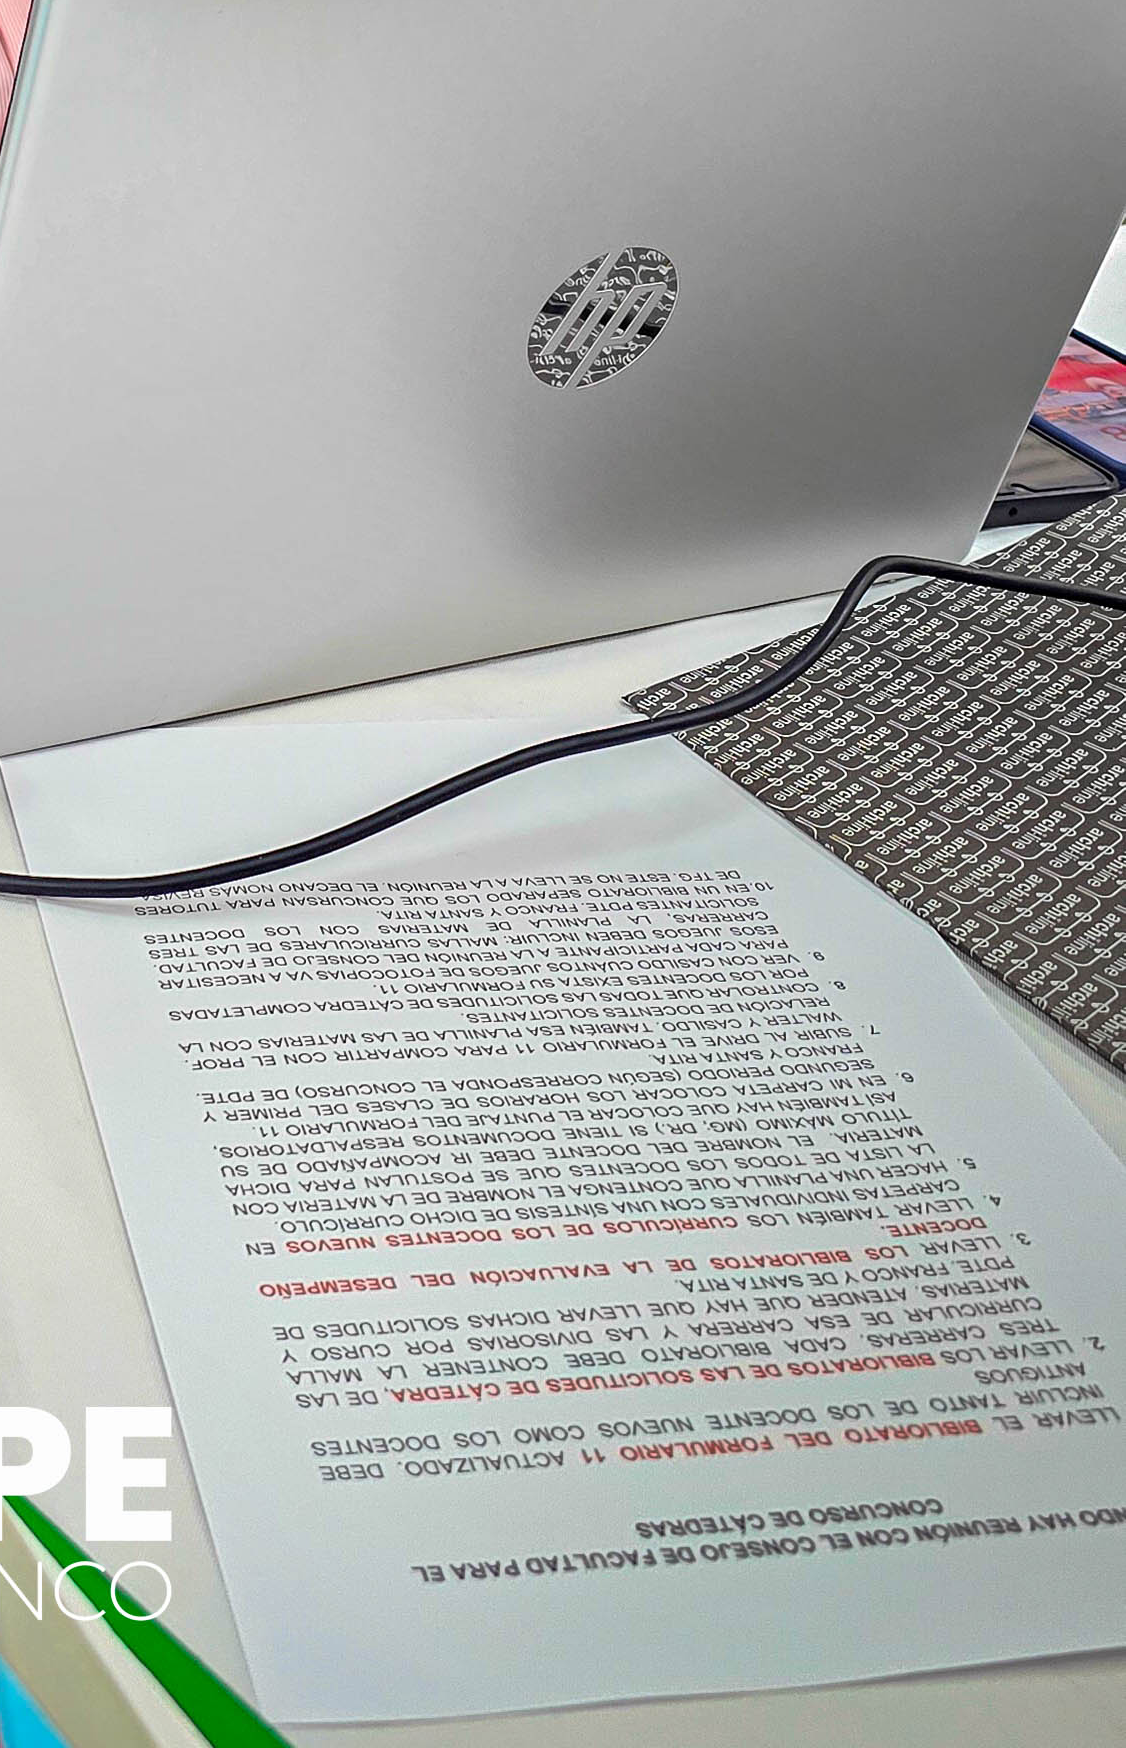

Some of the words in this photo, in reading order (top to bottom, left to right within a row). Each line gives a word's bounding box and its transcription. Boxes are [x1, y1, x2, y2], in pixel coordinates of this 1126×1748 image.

[378, 923, 469, 935] MATERIAS
[485, 921, 512, 932] DE
[528, 916, 612, 929] PLANILLA
[627, 915, 652, 925] LA
[143, 928, 245, 945] DOCENTES
[264, 925, 302, 936] LOS
[319, 924, 361, 936] CON
[746, 1213, 790, 1227] LOS
[796, 1205, 890, 1226] TAMBIÉN
[511, 1225, 555, 1240] LOS
[562, 1223, 594, 1237] DE
[602, 1216, 738, 1234] CURRÍCULOS
[285, 1236, 376, 1254] NUEVOS
[385, 1229, 503, 1247] DOCENTES
[245, 1242, 276, 1256] EN
[864, 1245, 909, 1261] LOS
[622, 1260, 654, 1274] LA
[665, 1258, 698, 1272] DE
[709, 1250, 853, 1270] BIBLIORATOS
[410, 1273, 456, 1287] DEL
[469, 1263, 611, 1287] EVALUACIÓN
[259, 1276, 397, 1299] DESEMPEÑO
[991, 1415, 1024, 1431] EL
[1031, 1406, 1121, 1429] LLEVAR
[783, 1431, 833, 1449] DEL
[844, 1419, 984, 1444] BIBLIORATO
[581, 1447, 606, 1464] 11
[619, 1435, 775, 1462] FORMULARIO
[318, 1463, 385, 1481] DEBE
[397, 1450, 564, 1478] ACTUALIZADO.
[768, 1510, 806, 1529] DE
[808, 1498, 944, 1526] CONCURSO
[635, 1513, 766, 1540] CÁTEDRAS
[912, 1517, 1023, 1544] REUNIÓN
[1027, 1512, 1078, 1533] HAY
[818, 1532, 854, 1552] EL
[854, 1527, 910, 1548] CON
[659, 1546, 697, 1566] DE
[699, 1536, 817, 1562] CONSEJO
[449, 1559, 521, 1581] PARA
[525, 1548, 658, 1576] FACULTAD
[410, 1565, 446, 1584] EL
